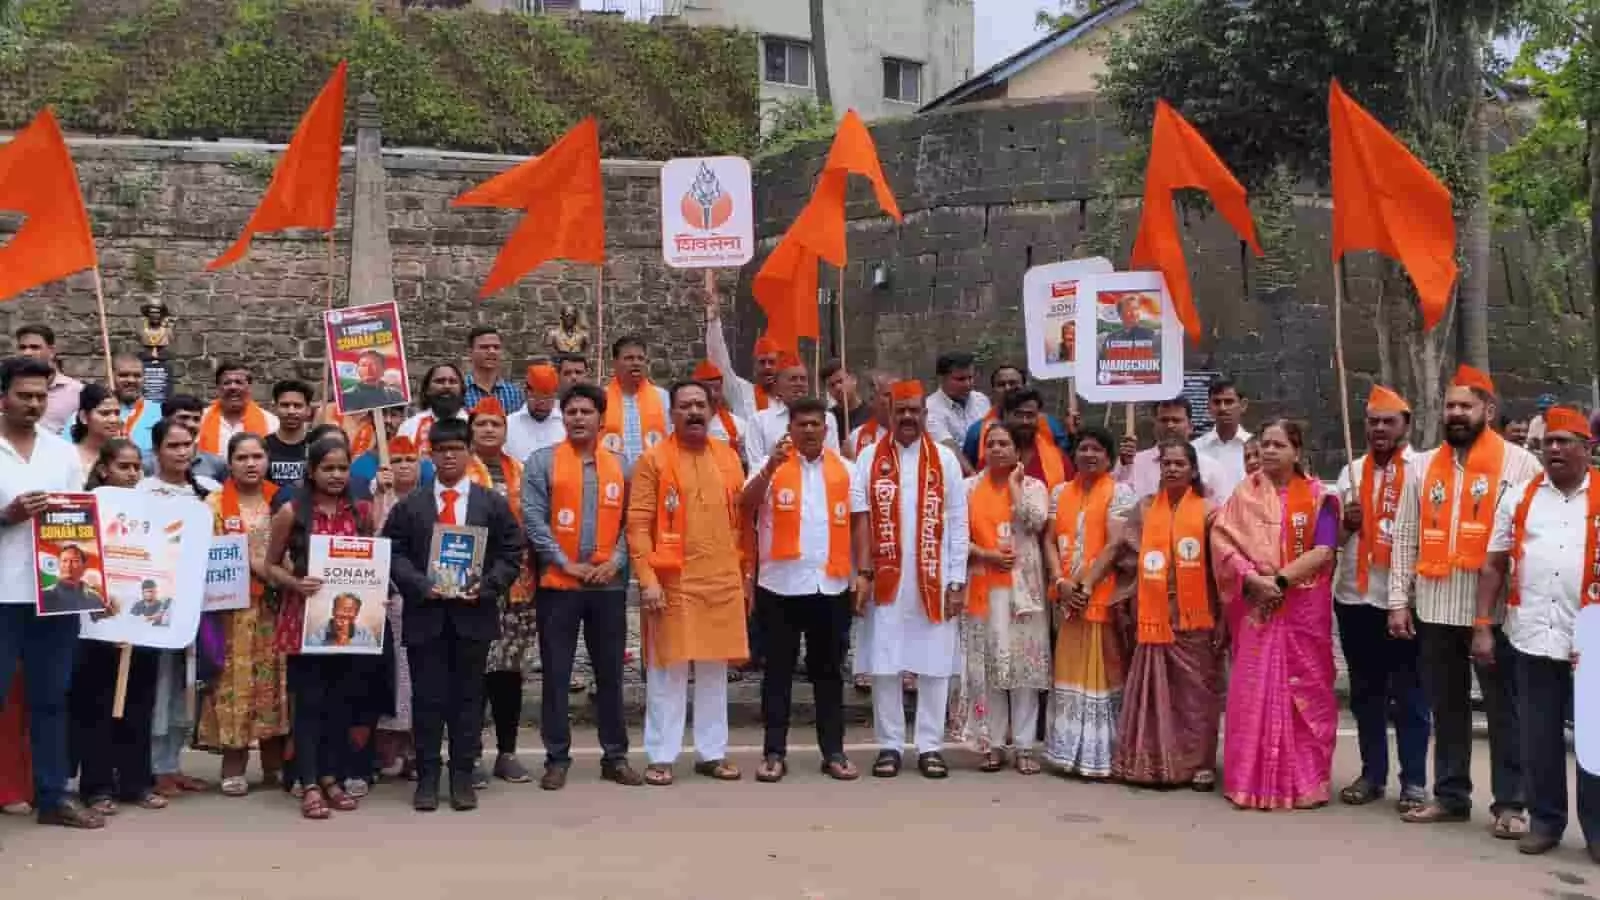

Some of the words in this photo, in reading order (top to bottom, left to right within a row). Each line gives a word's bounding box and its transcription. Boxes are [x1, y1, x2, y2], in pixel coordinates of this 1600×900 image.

[673, 233, 744, 252] शिवसेना
[1099, 359, 1161, 371] WANGCHUK
[323, 567, 376, 578] SONAM
